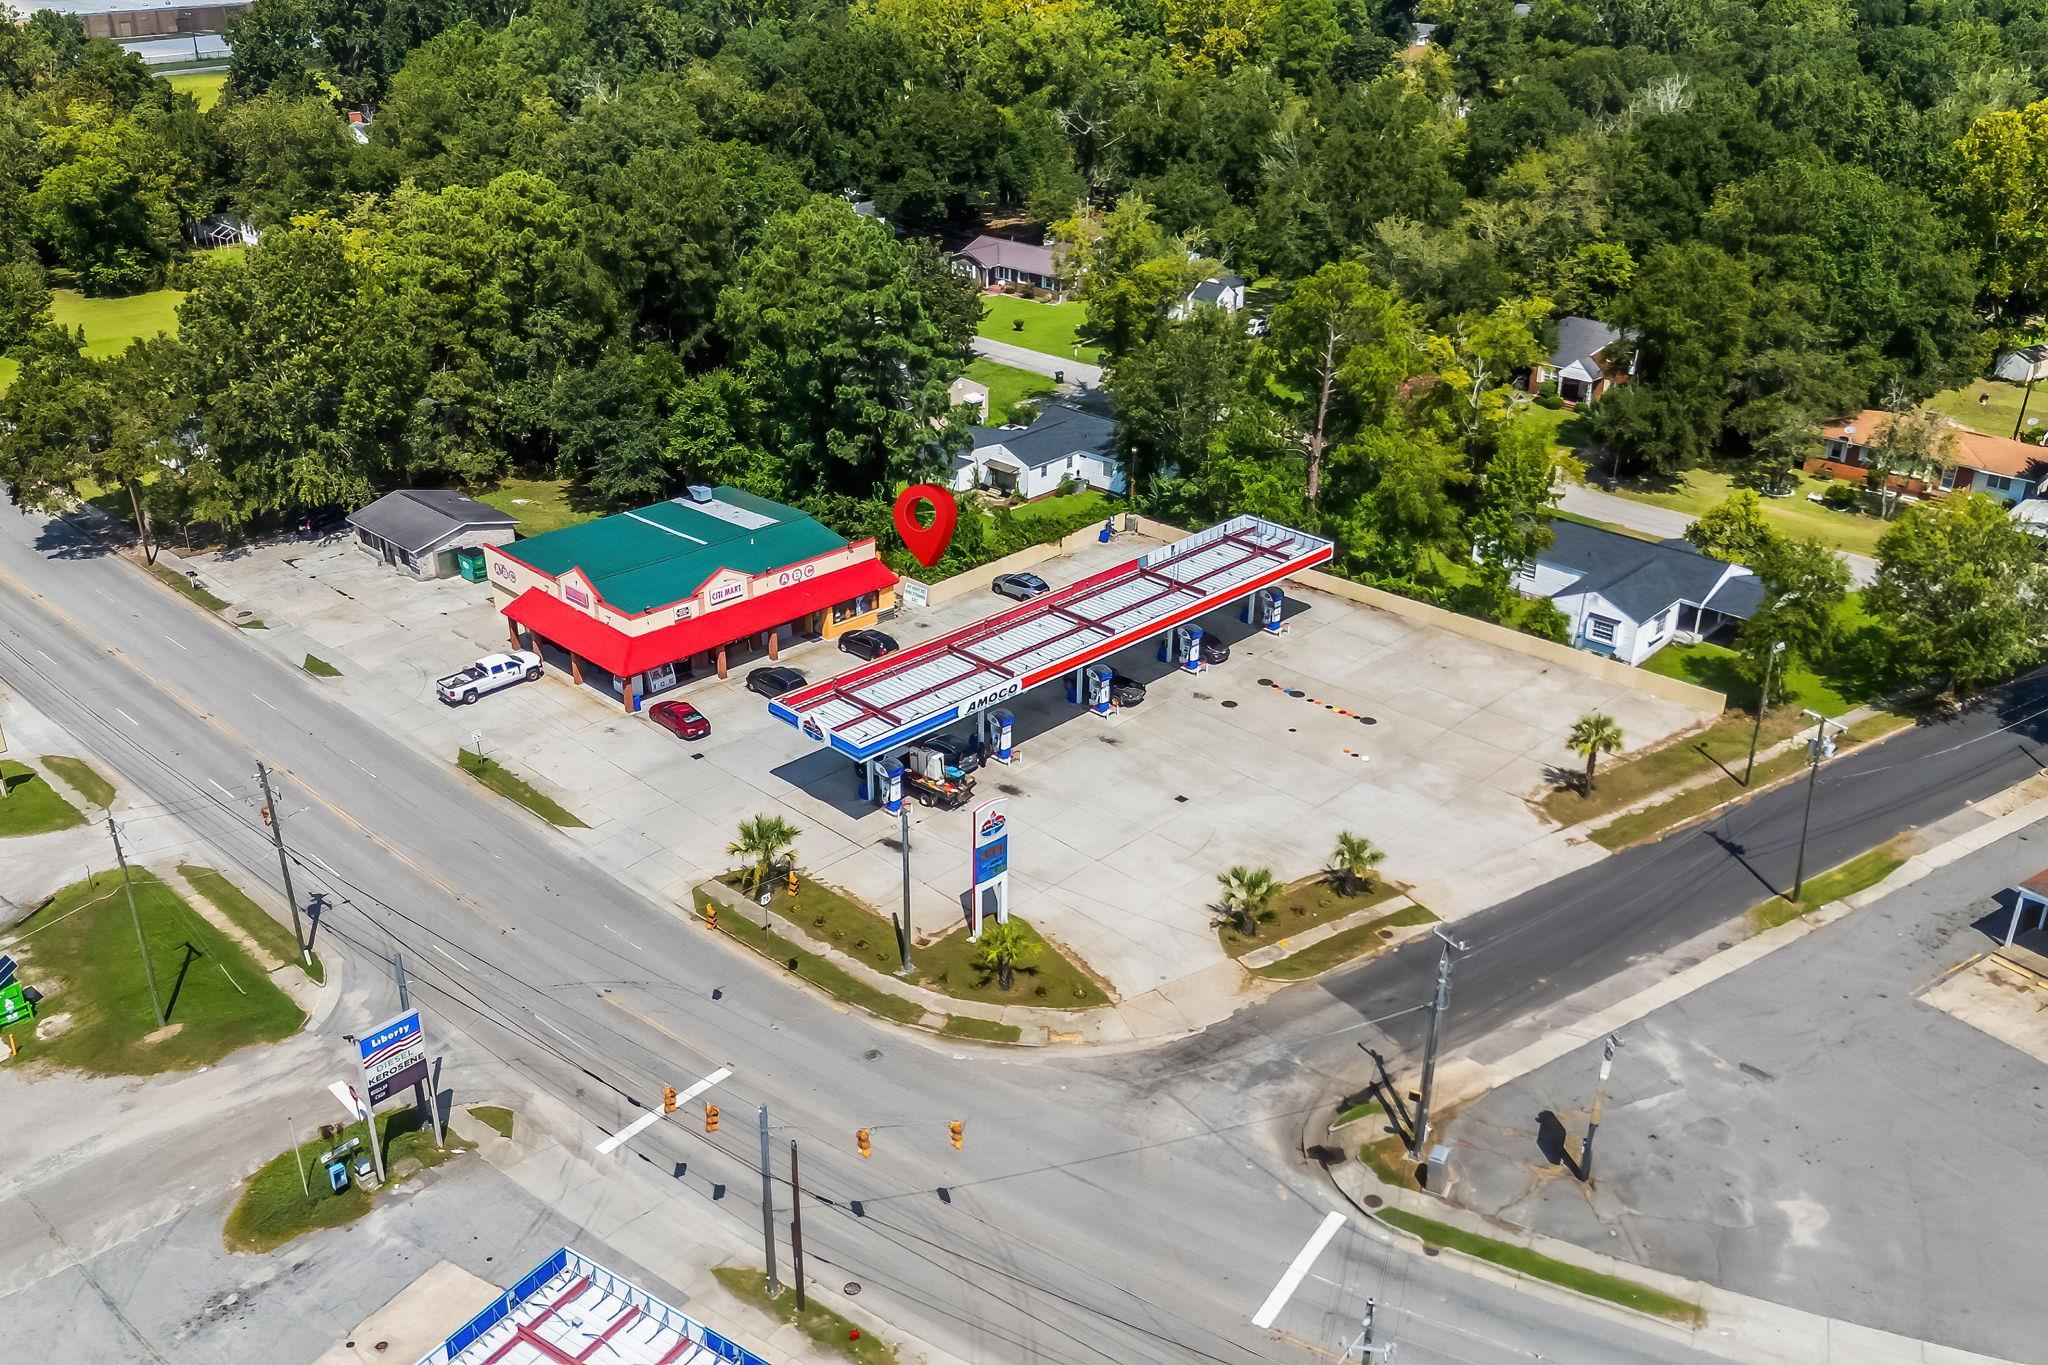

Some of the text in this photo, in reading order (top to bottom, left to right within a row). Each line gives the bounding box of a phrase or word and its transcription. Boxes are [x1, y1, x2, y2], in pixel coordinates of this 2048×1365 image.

[711, 584, 742, 601] CITI MART
[966, 683, 1018, 714] AMOCO
[368, 1052, 425, 1086] KEROSENE
[376, 1049, 413, 1073] DIESEL
